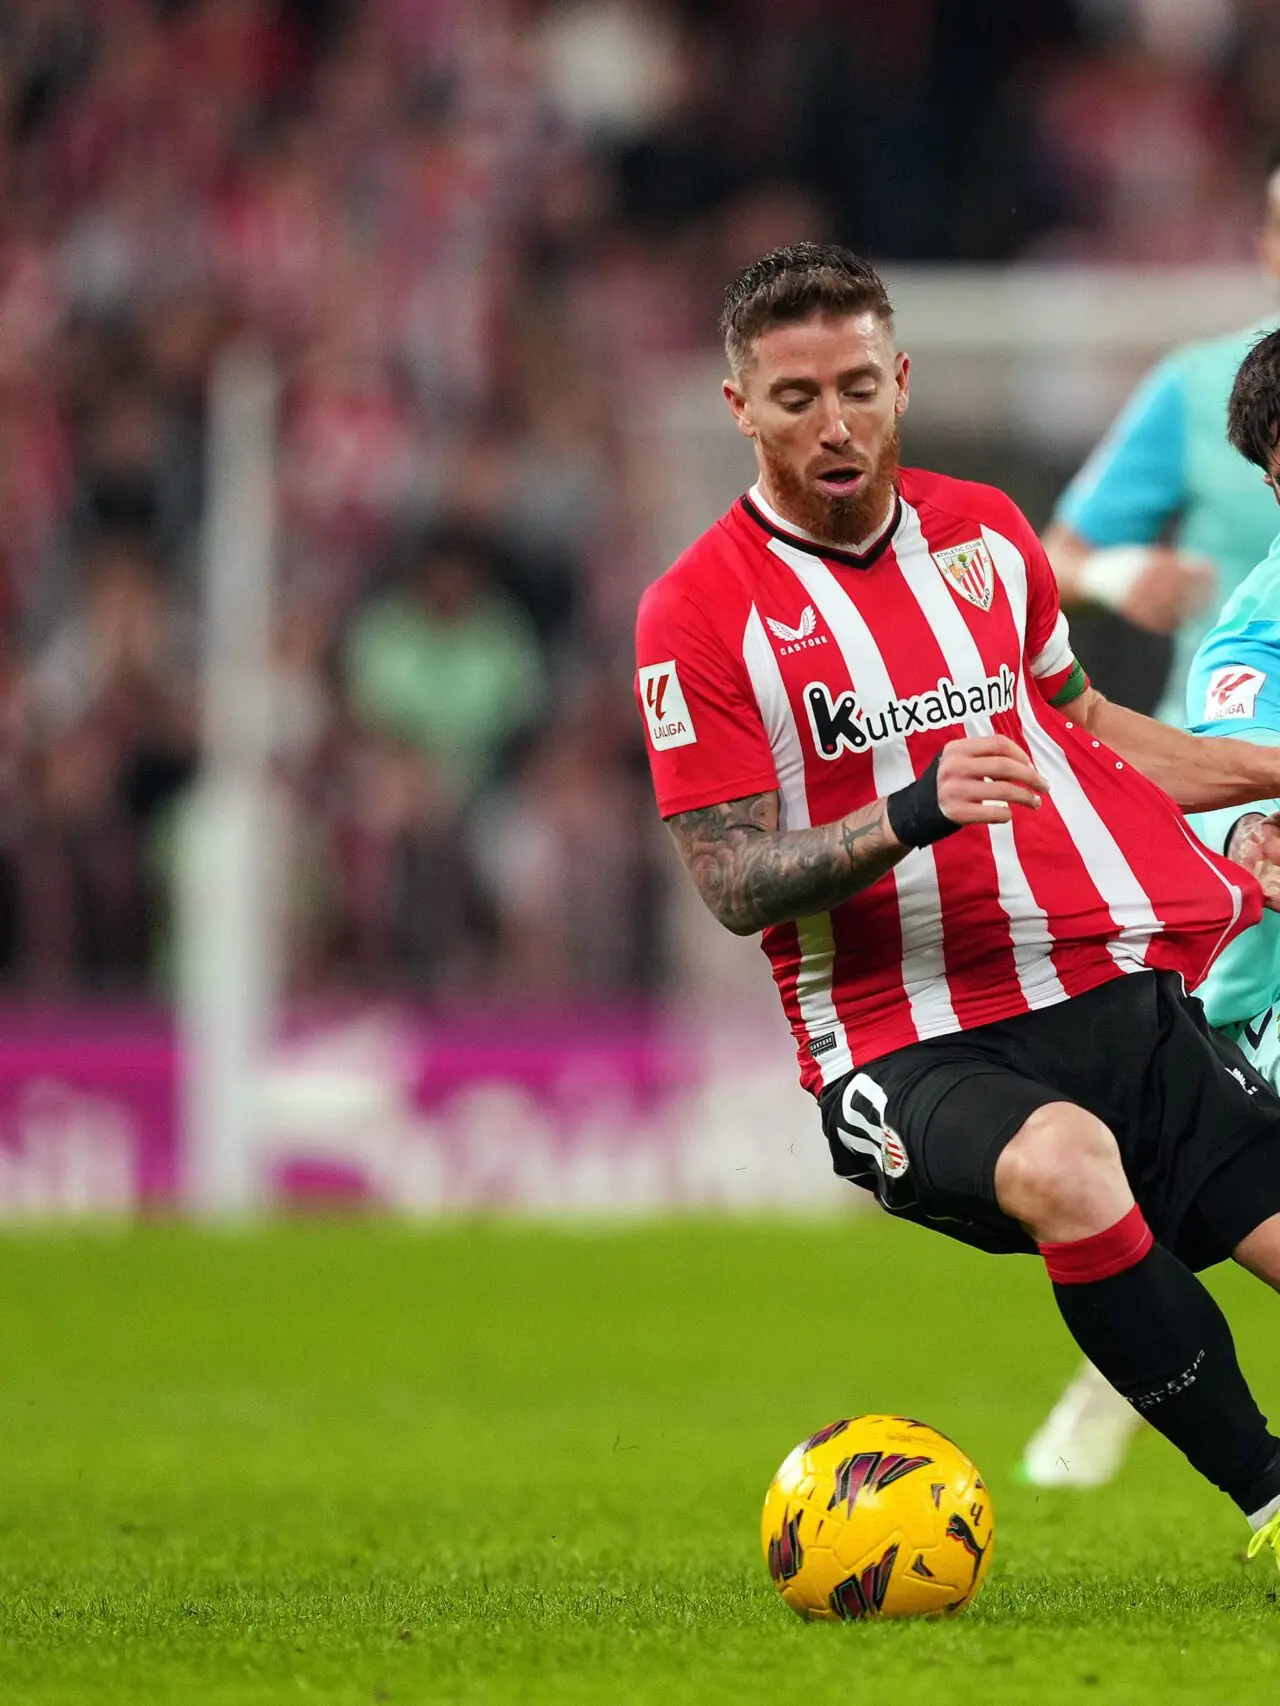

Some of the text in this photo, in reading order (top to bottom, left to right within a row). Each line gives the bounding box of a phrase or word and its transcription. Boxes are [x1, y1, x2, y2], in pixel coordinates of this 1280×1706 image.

[936, 541, 982, 558] ATHLETIC CLUB
[780, 635, 828, 656] CASTORE
[809, 670, 1014, 755] Kutxabank
[653, 721, 687, 739] LALIGA
